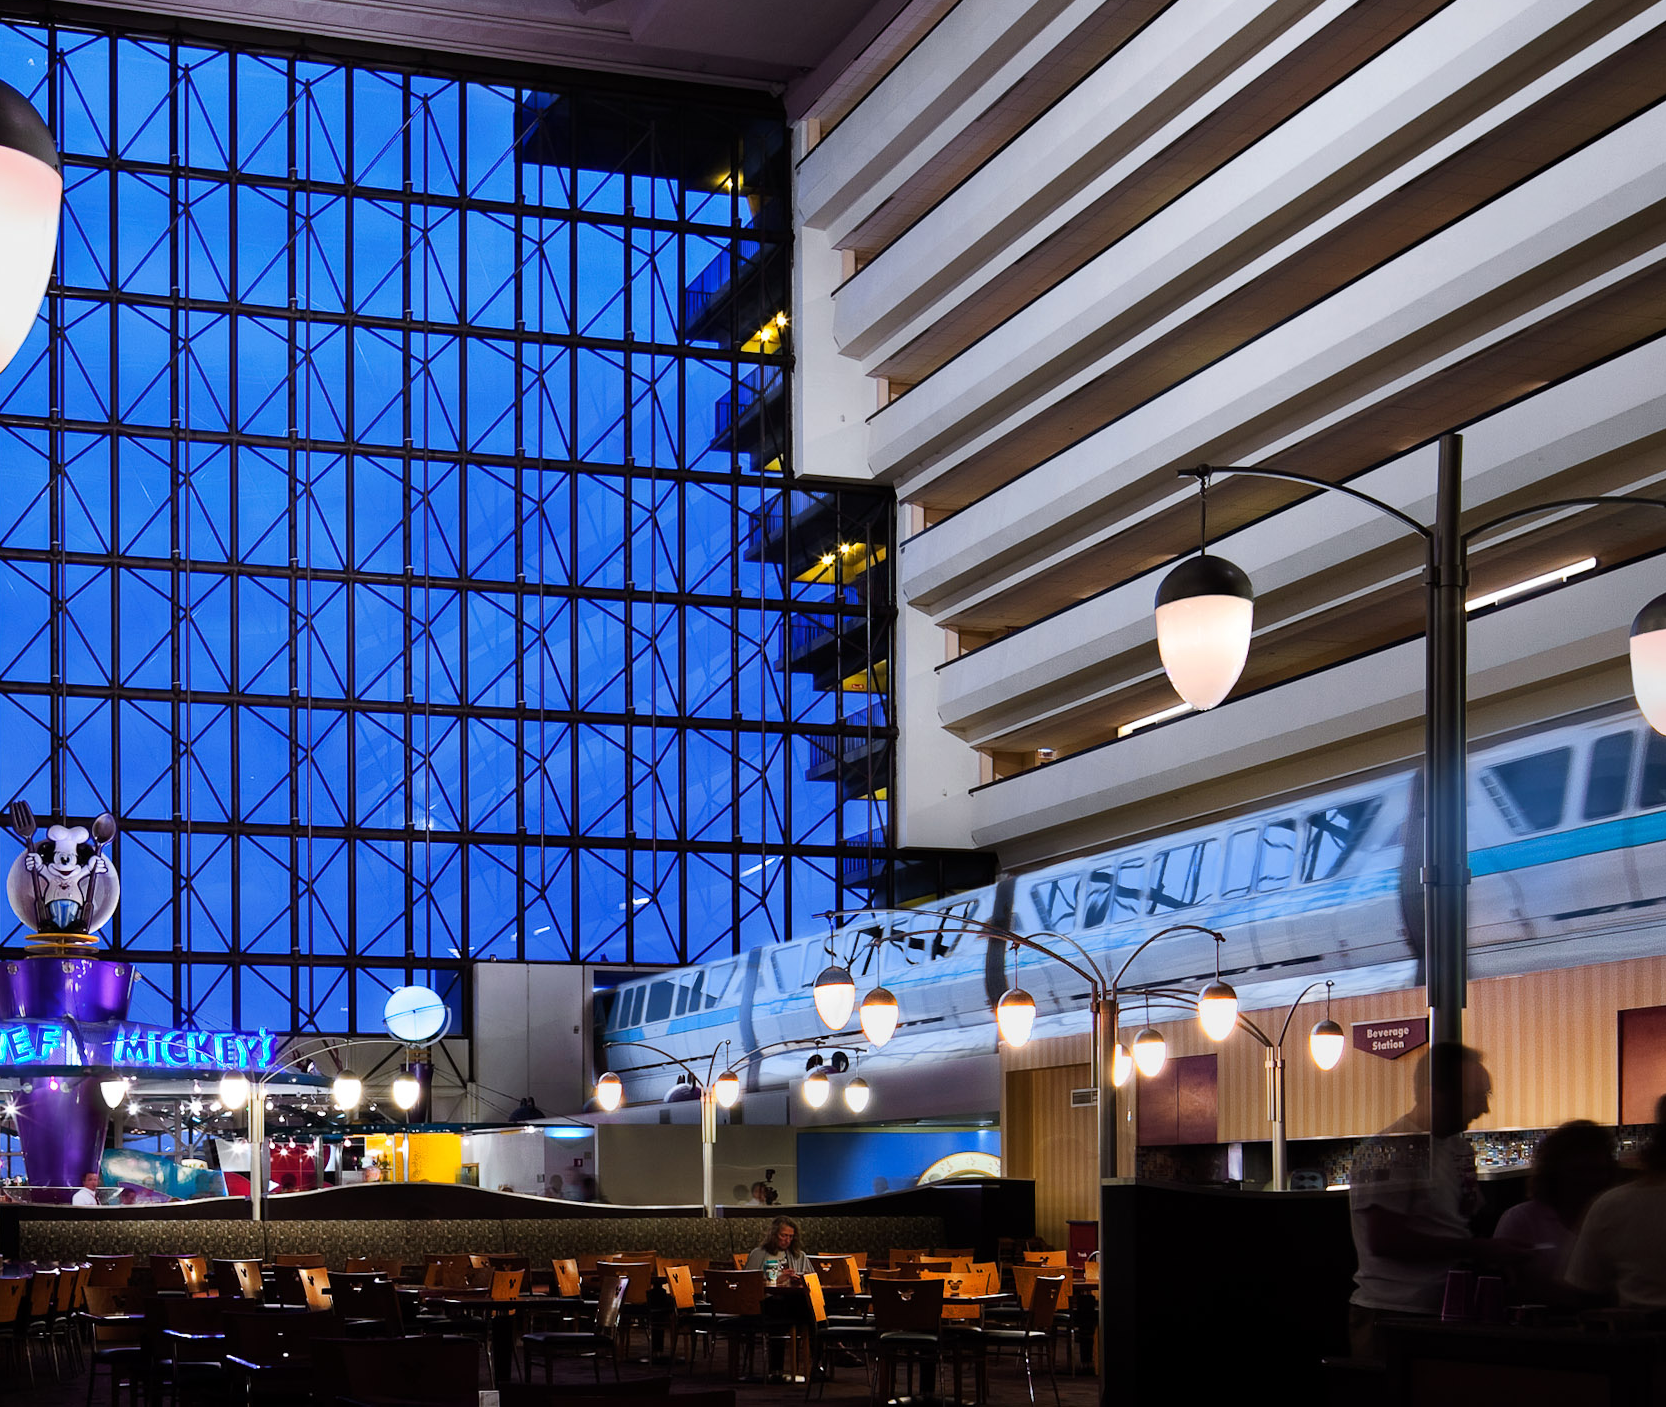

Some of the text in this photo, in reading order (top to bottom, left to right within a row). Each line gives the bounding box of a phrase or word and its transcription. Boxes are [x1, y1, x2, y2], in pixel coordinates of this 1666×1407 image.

[1366, 1027, 1410, 1039] Beverage
[111, 1024, 279, 1069] MICKEY'S
[1372, 1039, 1405, 1051] Station
